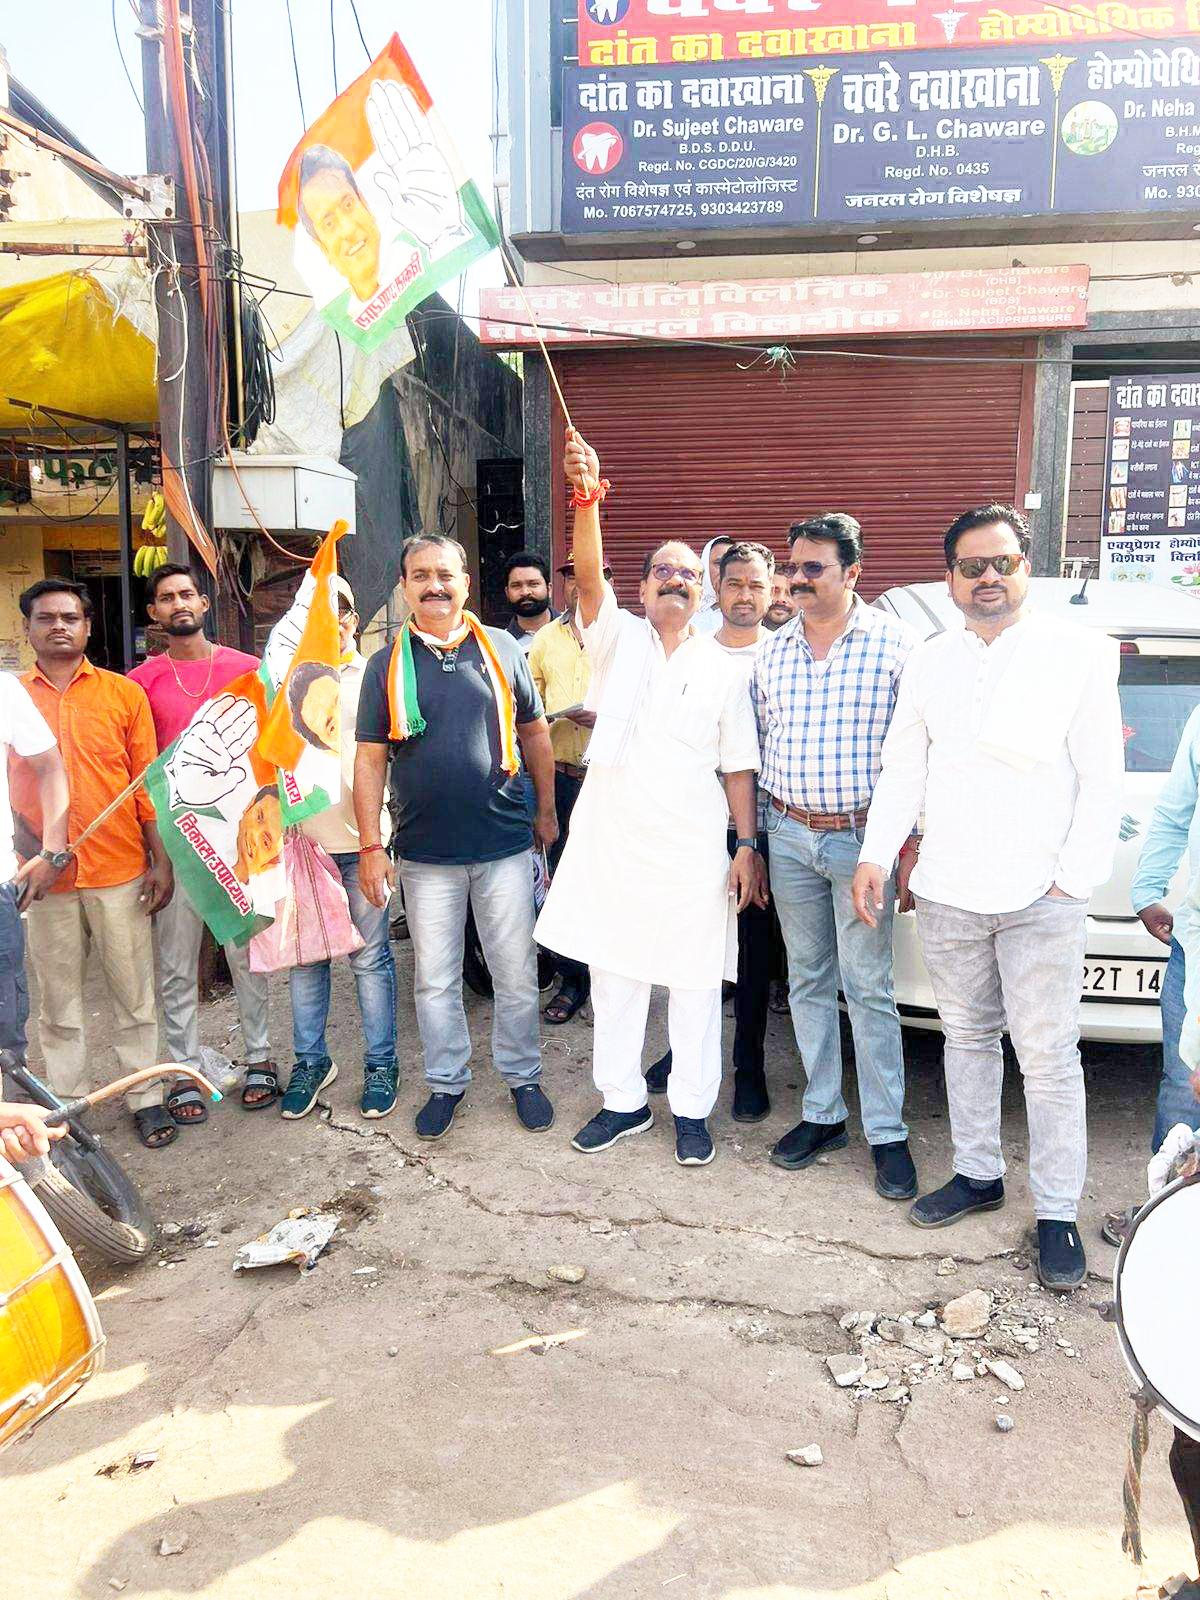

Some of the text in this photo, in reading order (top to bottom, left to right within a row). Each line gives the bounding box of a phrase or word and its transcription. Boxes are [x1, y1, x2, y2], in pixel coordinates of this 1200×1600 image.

[588, 22, 918, 65] दांत का दवाखाना
[579, 74, 804, 112] दांत का दवाखाना
[842, 61, 1041, 114] चवरे दवाखाना
[1124, 98, 1195, 119] Dr. Neha
[633, 116, 804, 140] Dr. Sujeet Chaware
[833, 118, 1046, 144] Dr. G. L. Chaware
[679, 141, 756, 154] B.D.S. D.D.U.
[916, 144, 960, 158] D.H.B.
[638, 156, 797, 173] Regd. No. CGDC/20/G/3420
[885, 162, 990, 180] Regd. No. 0435
[1142, 164, 1189, 178] जनरल
[576, 182, 596, 200] दंत
[599, 181, 621, 198] रोग
[624, 180, 670, 198] विशेषज्ञ
[674, 179, 692, 198] एवं
[845, 192, 906, 208] जनरल
[908, 188, 944, 206] रोग
[1144, 186, 1172, 200] Mo.
[584, 201, 783, 218] Mo. 7067574725, 9303423789
[960, 286, 1010, 301] Sujeet
[960, 307, 1001, 318] Neha
[1005, 304, 1076, 316] Chaware
[978, 314, 1072, 325] ACUPRESSURE
[1116, 379, 1143, 408] दांत
[1147, 384, 1167, 408] का
[177, 813, 216, 860] विकास
[1136, 968, 1160, 993] 14
